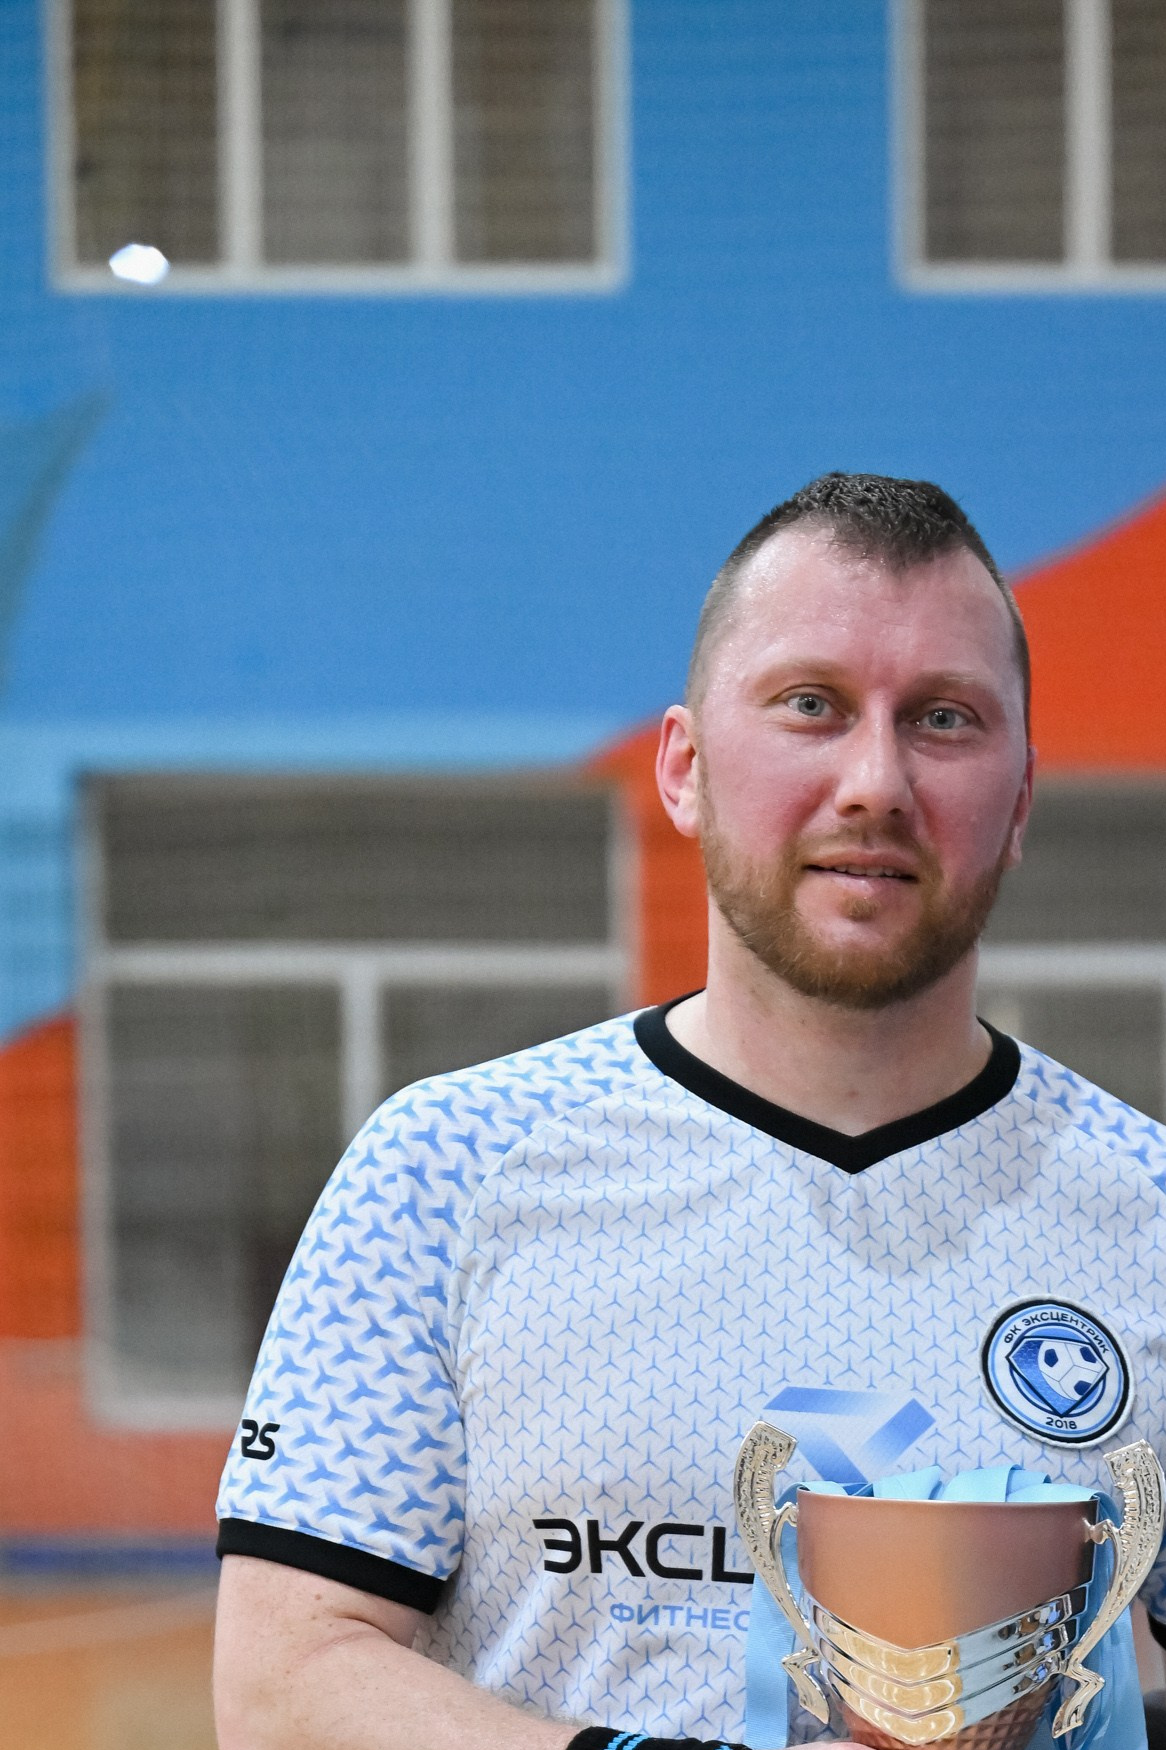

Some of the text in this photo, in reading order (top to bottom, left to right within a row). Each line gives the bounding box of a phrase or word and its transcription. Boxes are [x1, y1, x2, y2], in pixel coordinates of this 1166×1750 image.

[1003, 1311, 1110, 1354] ФК ЭКСЦЕНТРИК
[1045, 1416, 1078, 1430] 2018
